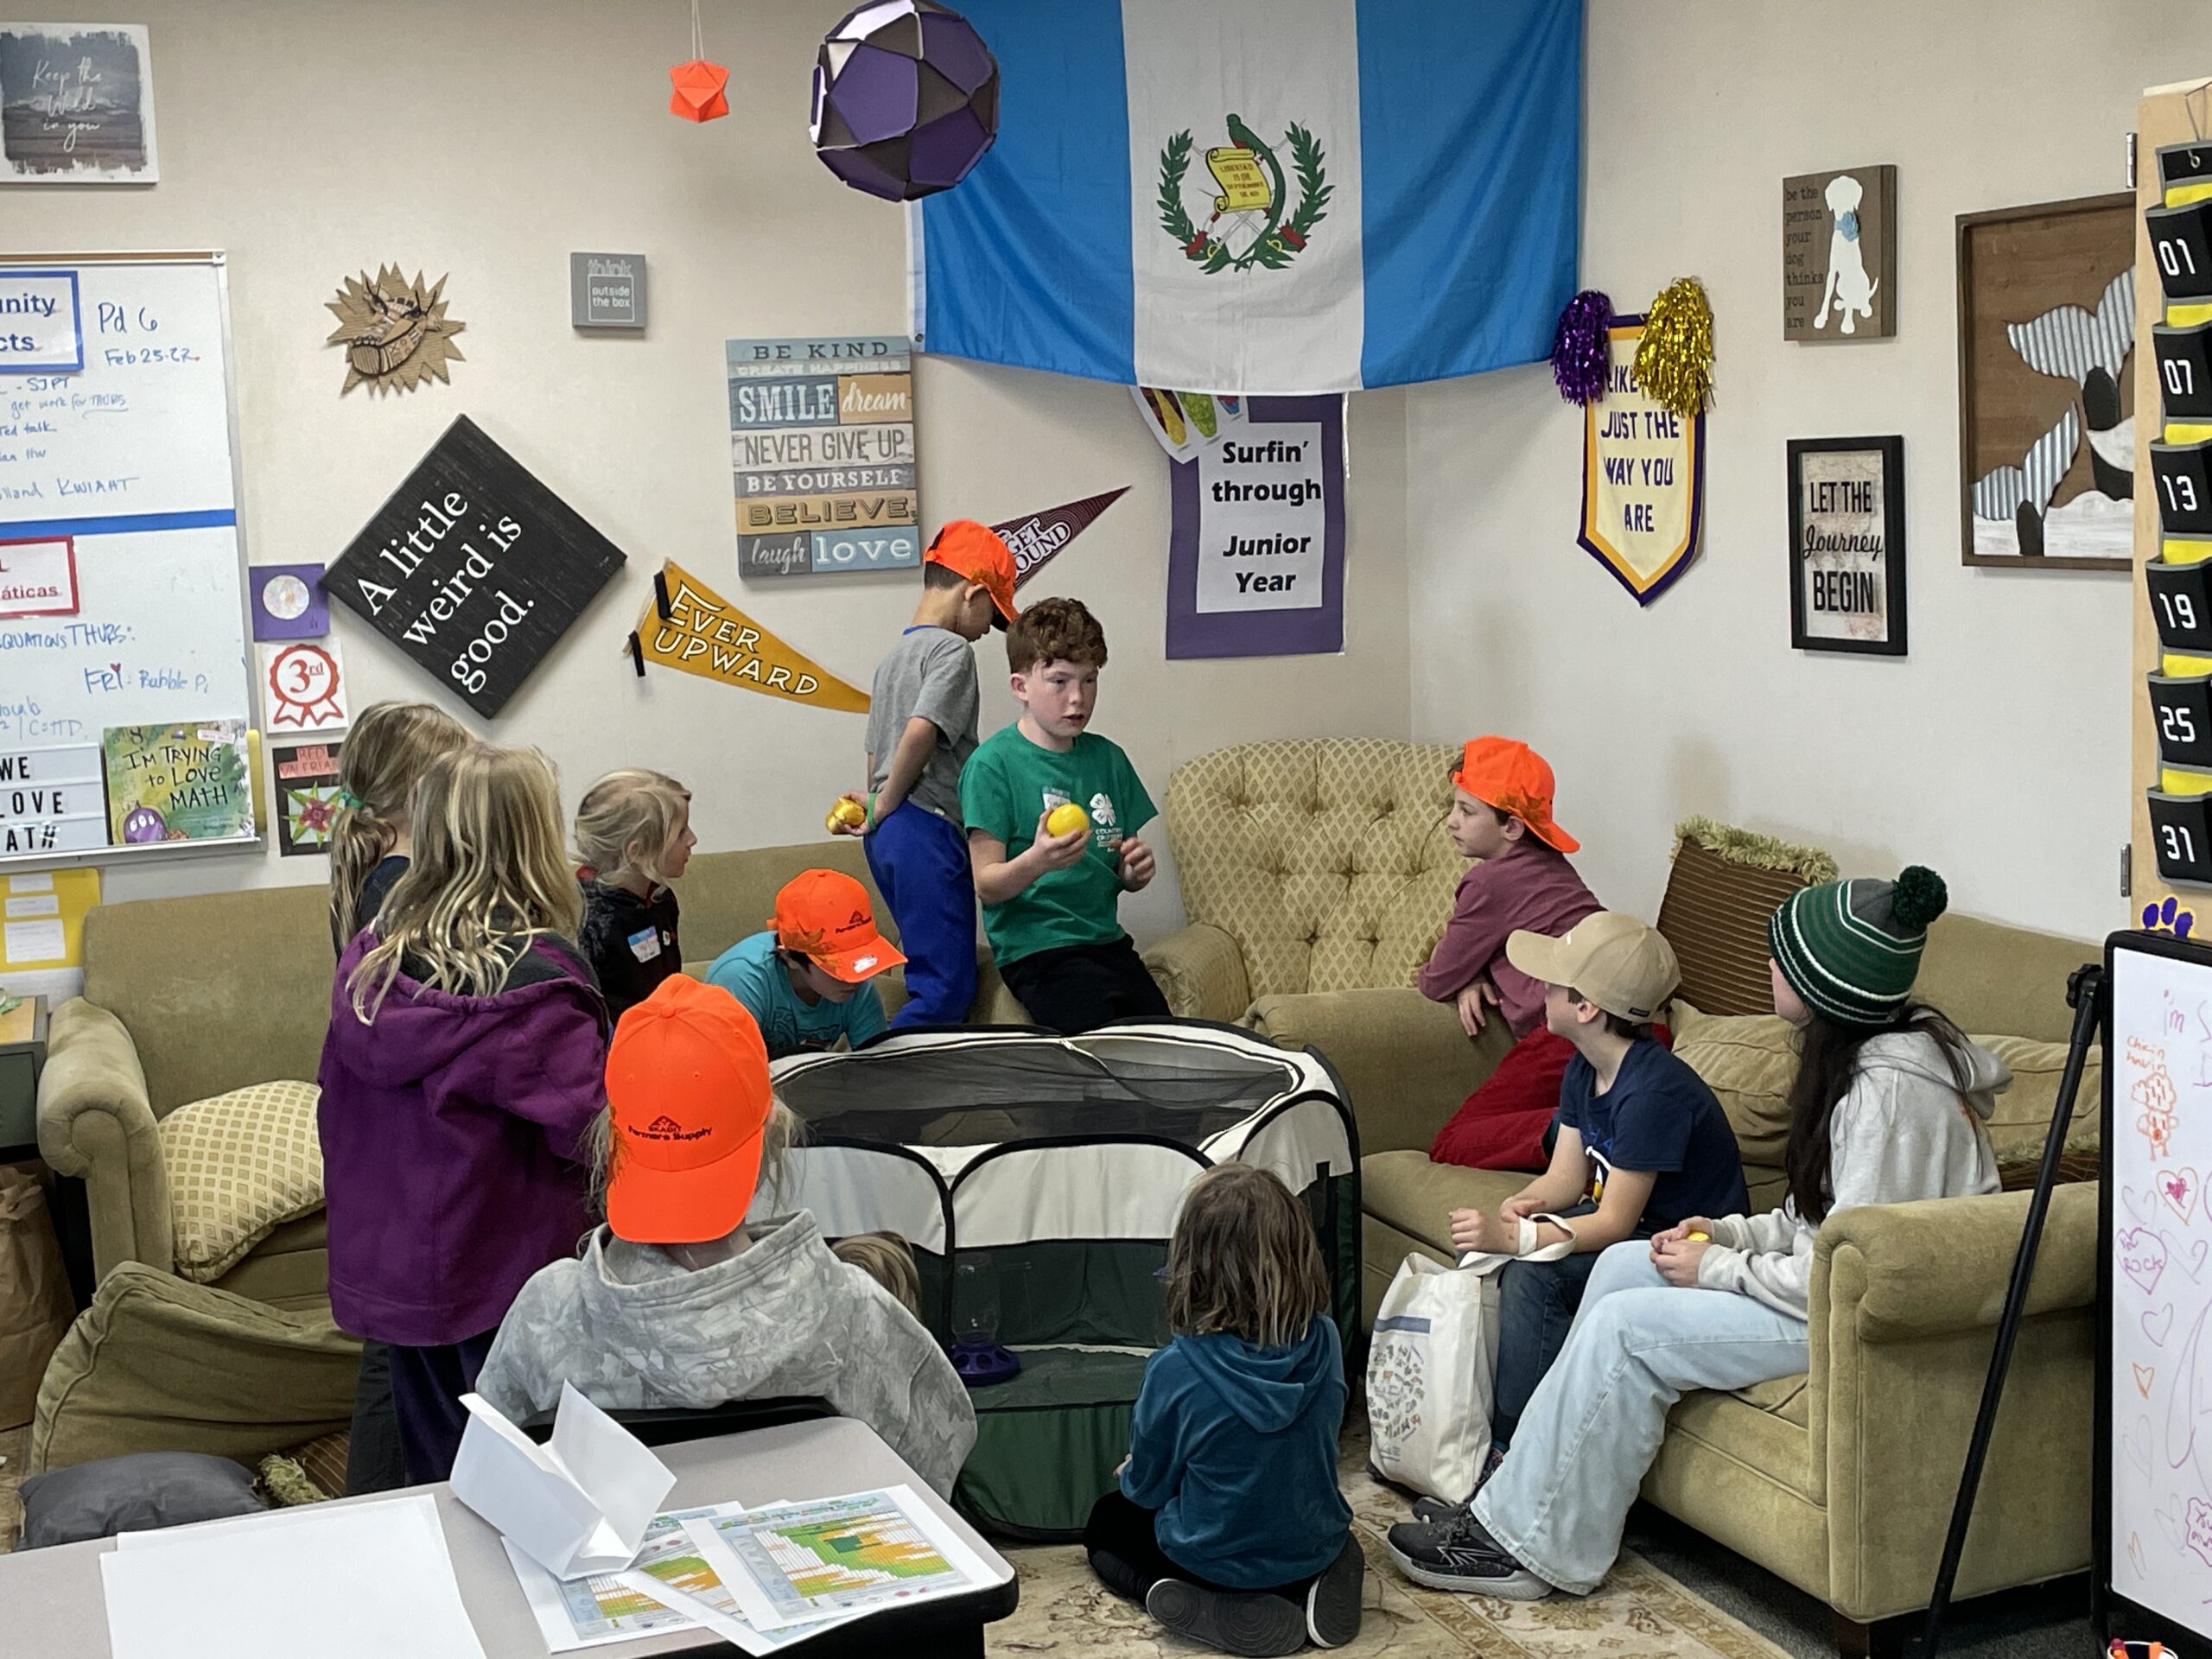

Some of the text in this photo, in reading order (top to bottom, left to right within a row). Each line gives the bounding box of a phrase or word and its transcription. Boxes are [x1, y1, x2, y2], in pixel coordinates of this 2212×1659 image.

[33, 57, 103, 95] Keep the
[63, 123, 100, 152] you
[1786, 187, 1819, 200] be the
[1786, 209, 1822, 226] person
[1786, 231, 1812, 247] your
[1786, 253, 1804, 266] dog
[2158, 238, 2196, 276] 01
[592, 286, 630, 296] outside
[1786, 271, 1824, 286] thinks
[593, 296, 631, 308] the box
[1786, 296, 1804, 310] you
[99, 302, 158, 334] Pd 6
[1787, 316, 1805, 328] are
[753, 342, 888, 359] BE KIND
[736, 359, 901, 376] CREATE HAPPINESS
[2164, 359, 2193, 395] 07
[738, 381, 906, 423] SMILE dream
[1601, 411, 1680, 439] JUST THE
[744, 429, 905, 465] NEVER GIVE UP
[747, 469, 903, 493] BE YOURSELF
[1604, 457, 1674, 486] WAY YOU
[1211, 479, 1322, 507] through
[1810, 481, 1872, 512] LET THE
[2162, 474, 2196, 512] 13
[747, 497, 909, 526] BELIEVE
[1624, 504, 1655, 532] ARE
[1002, 519, 1042, 556] GET
[1015, 524, 1070, 571] OUND
[1223, 533, 1312, 557] Junior
[1803, 524, 1884, 562] Journey
[357, 492, 468, 616] A little
[752, 532, 912, 575] laugh love
[403, 515, 522, 645] weird is
[1236, 572, 1296, 594] Year
[1813, 570, 1874, 613] BEGIN
[666, 580, 761, 653] EVER
[2159, 593, 2196, 630] 19
[450, 590, 535, 694] good.
[654, 626, 819, 695] UPWARD
[2160, 706, 2196, 743] 25
[159, 745, 222, 766] TRYING
[145, 774, 165, 787] to
[0, 790, 64, 818] OVE
[2161, 825, 2196, 862] 31
